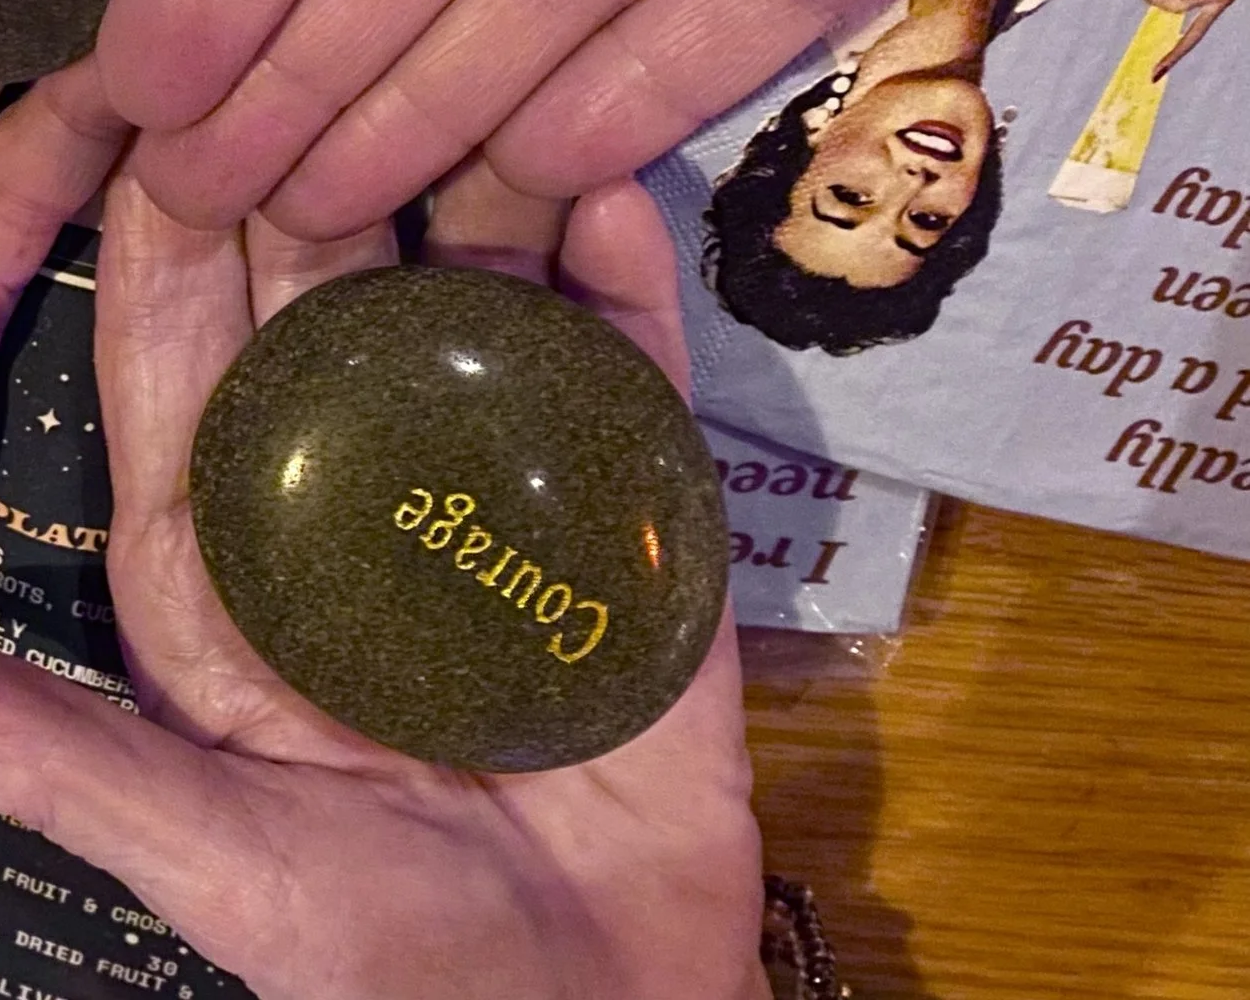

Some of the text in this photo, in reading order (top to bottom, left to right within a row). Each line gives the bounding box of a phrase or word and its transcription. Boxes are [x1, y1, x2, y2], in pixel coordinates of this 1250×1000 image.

[1033, 319, 1163, 398] day
[1169, 357, 1218, 395] a
[393, 487, 609, 664] Courage
[799, 540, 848, 585] I
[2, 866, 72, 905] FRUIT
[82, 896, 99, 915] &
[13, 929, 85, 967] DRIED
[95, 957, 168, 993] FRUIT
[145, 953, 179, 978] 30
